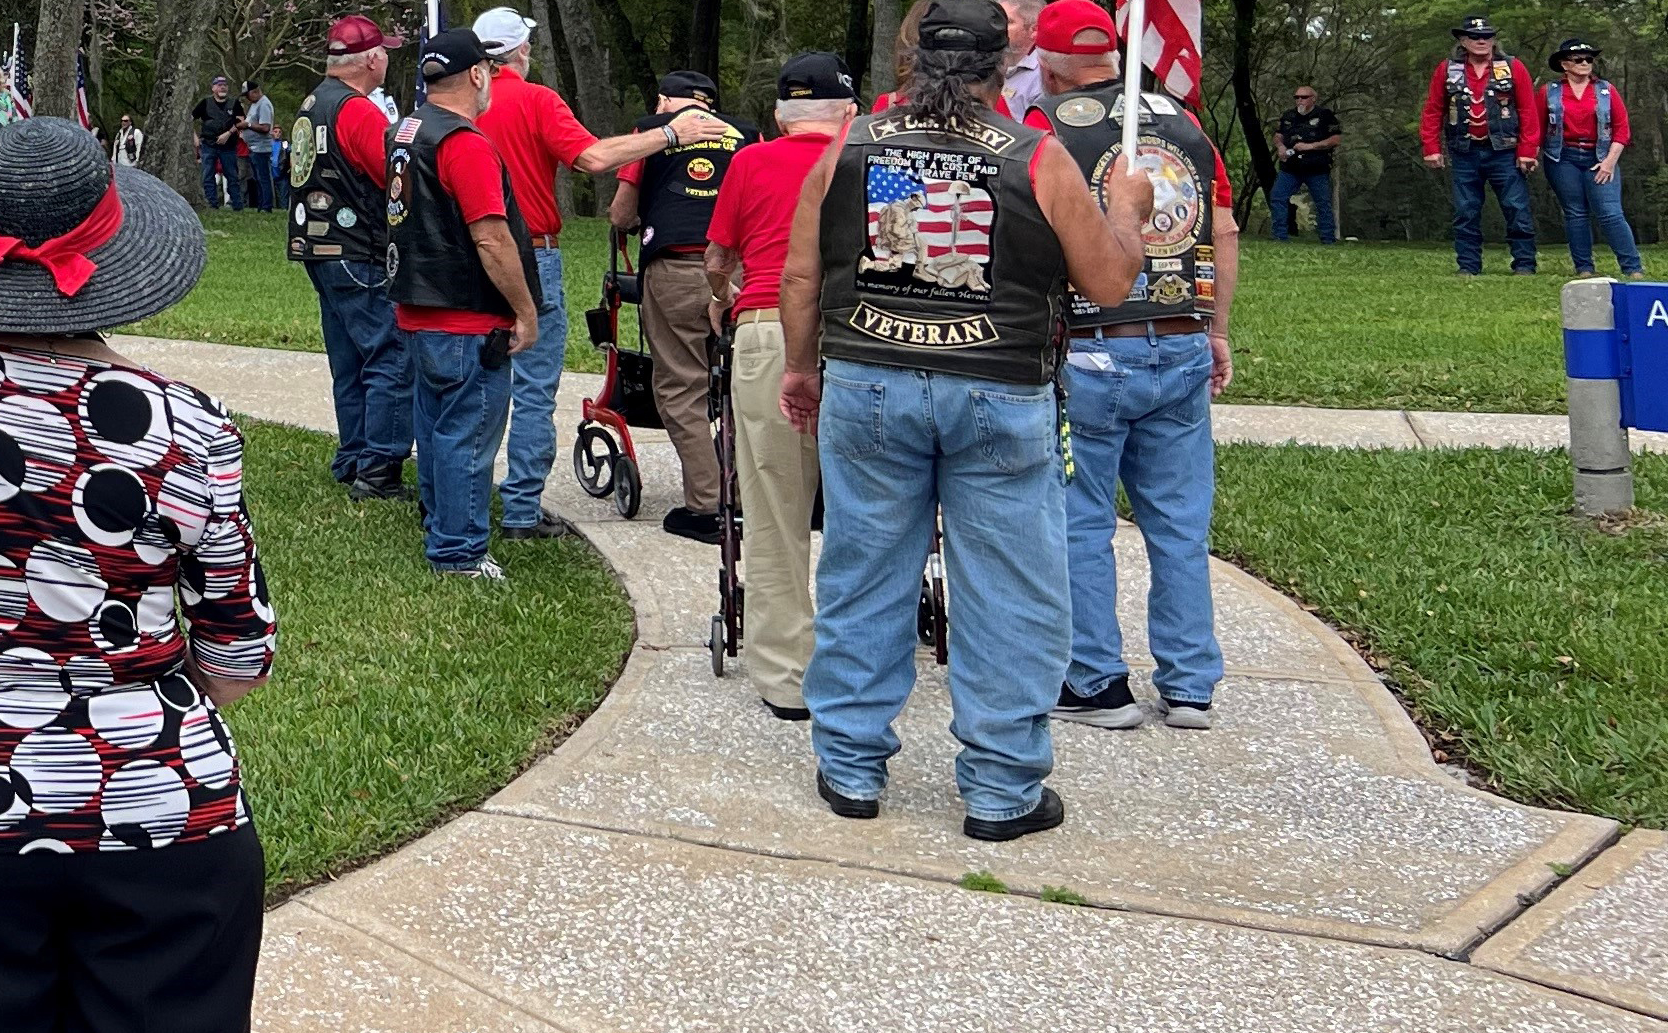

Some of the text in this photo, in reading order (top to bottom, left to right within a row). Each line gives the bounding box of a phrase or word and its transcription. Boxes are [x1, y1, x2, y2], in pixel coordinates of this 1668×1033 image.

[884, 148, 982, 164] THE HIGH PRICE OF
[1167, 142, 1184, 159] WILL
[867, 155, 998, 176] FREEDOM IS A COST PAID
[888, 165, 979, 181] BY A BRAVE FEW.
[868, 283, 899, 294] memory
[902, 284, 912, 295] of
[928, 285, 956, 298] fallen
[864, 308, 984, 345] VETERAN
